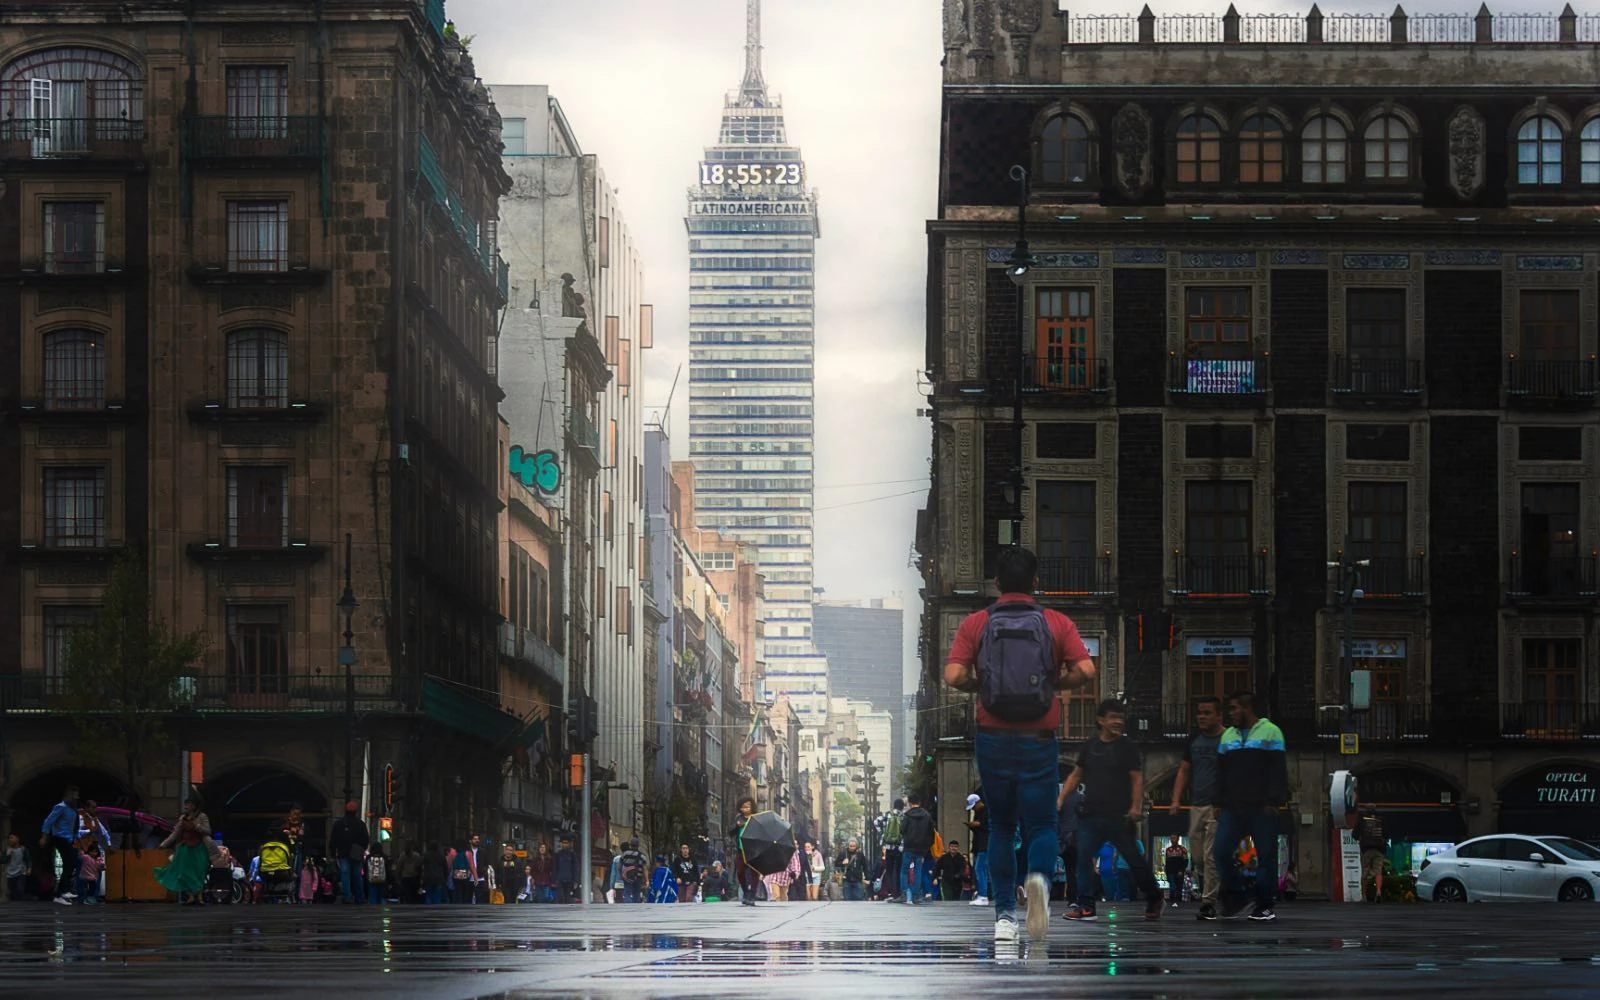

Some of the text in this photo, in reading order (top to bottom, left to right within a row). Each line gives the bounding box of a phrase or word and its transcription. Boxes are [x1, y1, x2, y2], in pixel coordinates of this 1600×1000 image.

[701, 164, 800, 184] 18:55:23
[695, 203, 808, 214] LATINOAMERICANA
[1546, 772, 1588, 783] OPTICA
[1537, 787, 1596, 803] TURATI
